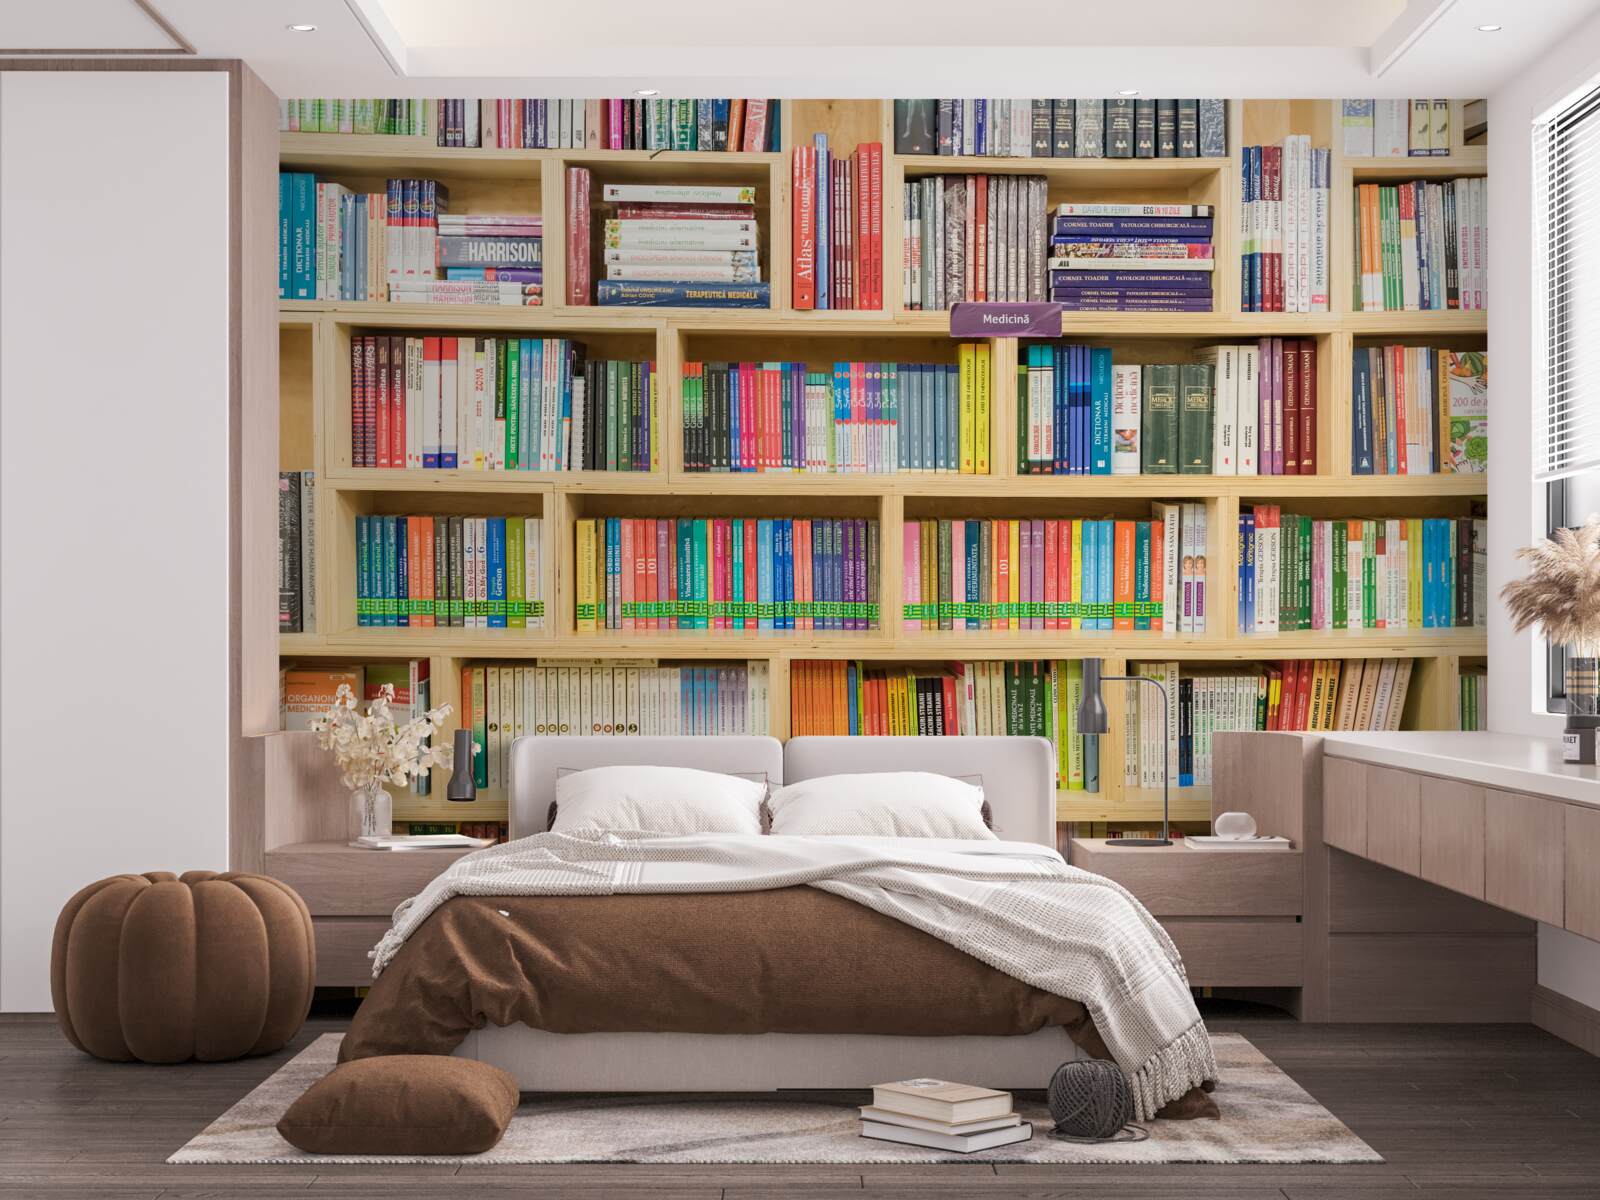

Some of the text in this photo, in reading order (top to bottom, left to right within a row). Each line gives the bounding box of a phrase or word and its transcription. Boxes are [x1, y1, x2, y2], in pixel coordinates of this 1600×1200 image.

[1143, 206, 1154, 215] ECG
[468, 242, 538, 262] HARRISON
[796, 239, 813, 281] Atlas
[983, 314, 1030, 324] Medicină
[1453, 397, 1468, 407] 200
[636, 558, 646, 575] 101
[647, 558, 657, 575] 101
[999, 558, 1008, 576] 101
[468, 575, 474, 587] My
[479, 575, 486, 587] My
[495, 568, 503, 596] Gerson
[468, 587, 473, 598] Oh
[479, 587, 485, 598] Oh
[1010, 688, 1018, 723] MEDICINALE
[1311, 701, 1320, 729] MEDICINEI
[1323, 701, 1333, 729] MEDICINEI
